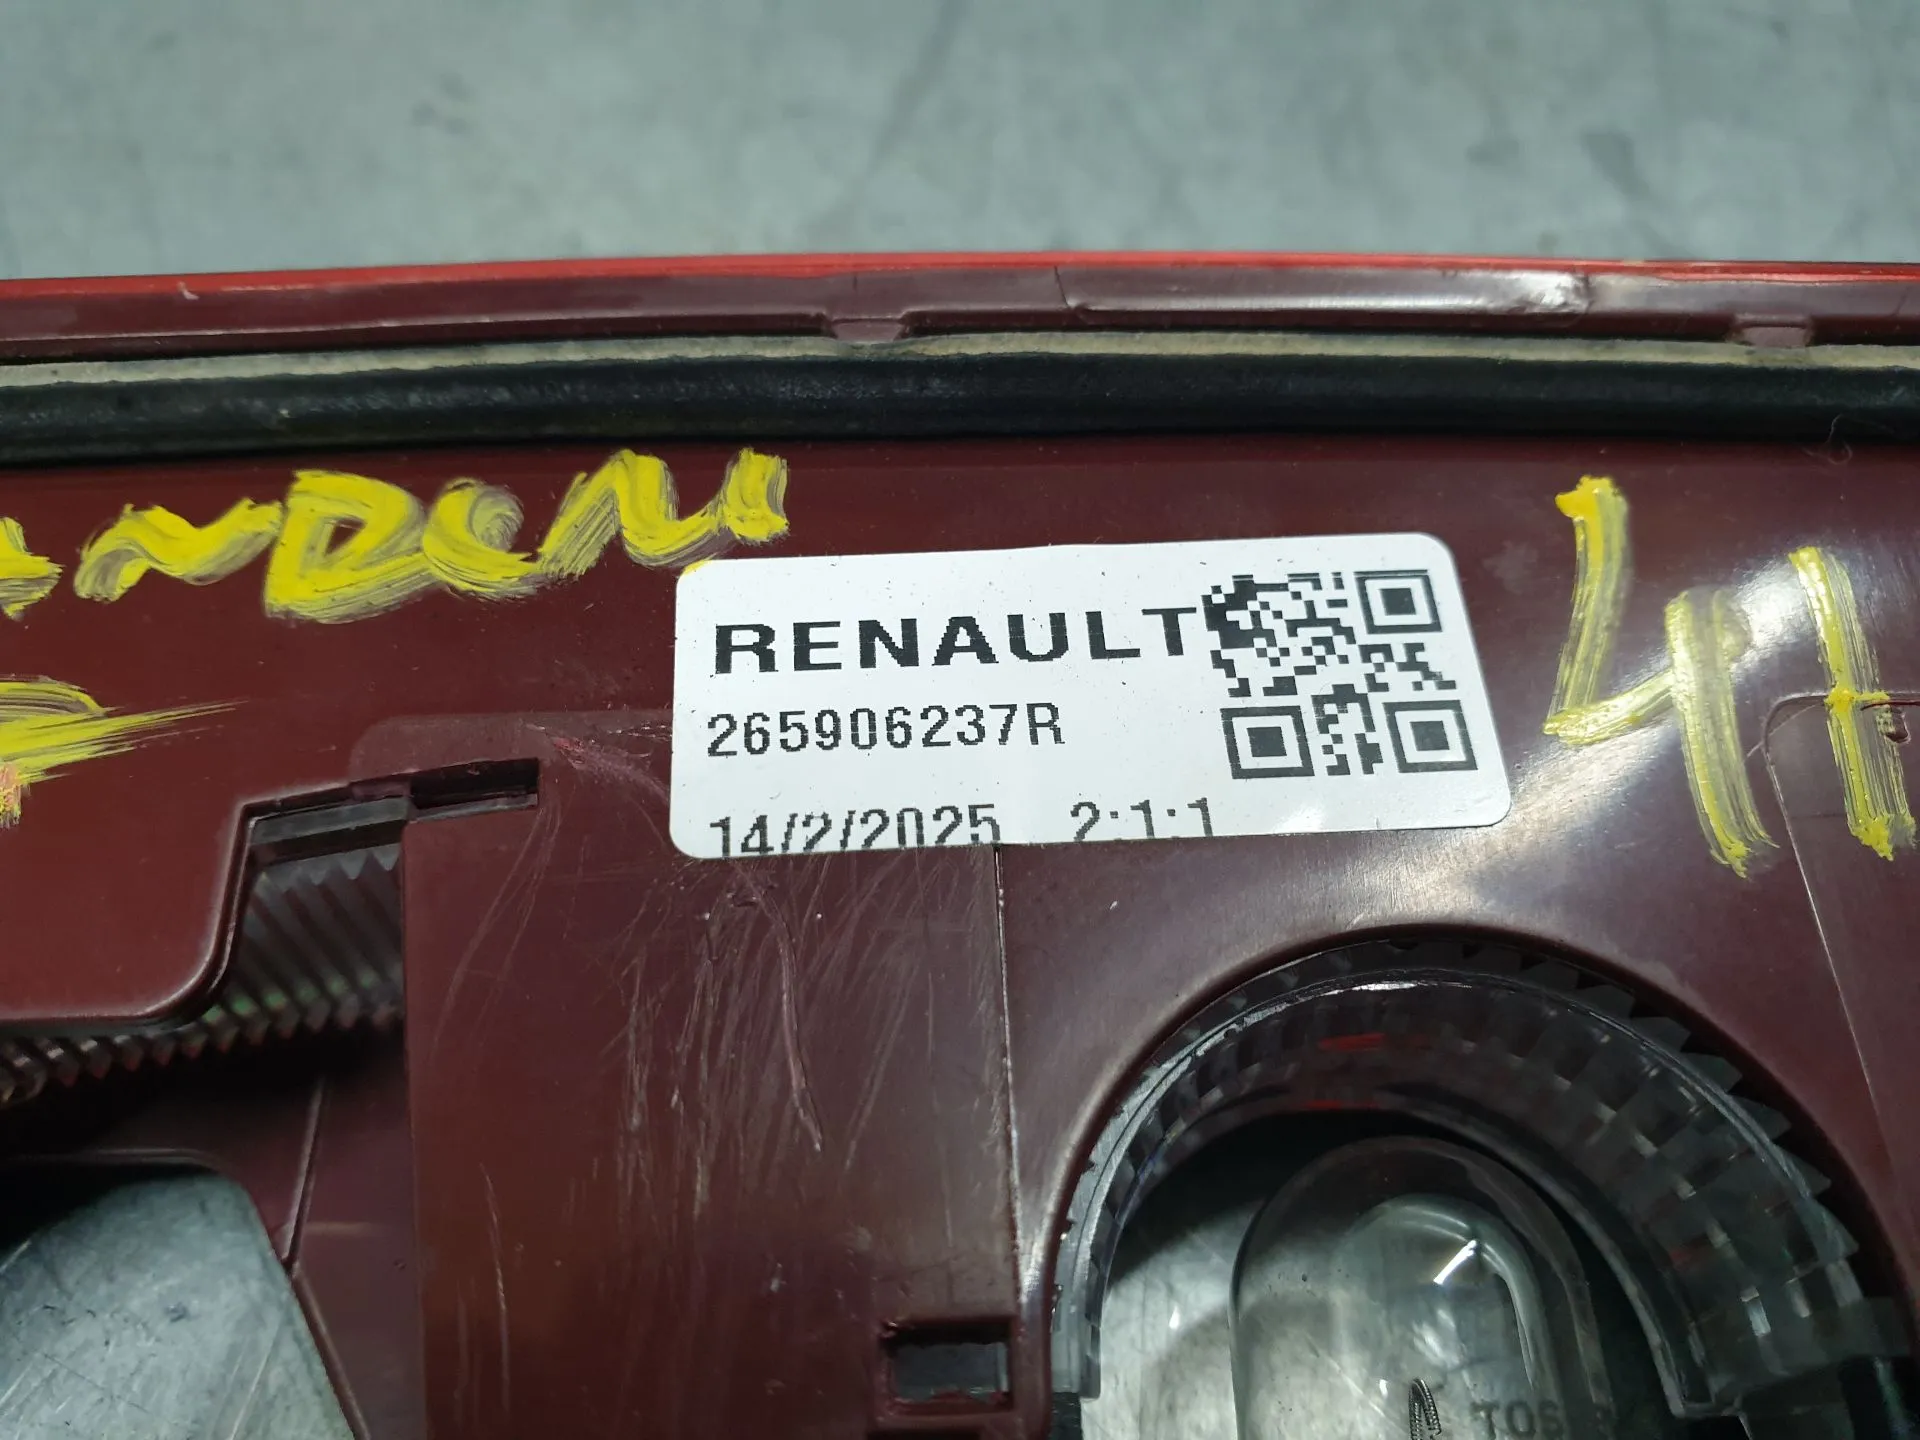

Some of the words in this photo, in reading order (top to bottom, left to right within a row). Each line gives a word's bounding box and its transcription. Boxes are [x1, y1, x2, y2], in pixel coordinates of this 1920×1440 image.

[714, 607, 1198, 675] RENAULT
[706, 702, 1066, 757] 265906237R
[708, 803, 1002, 857] 14/2/2025
